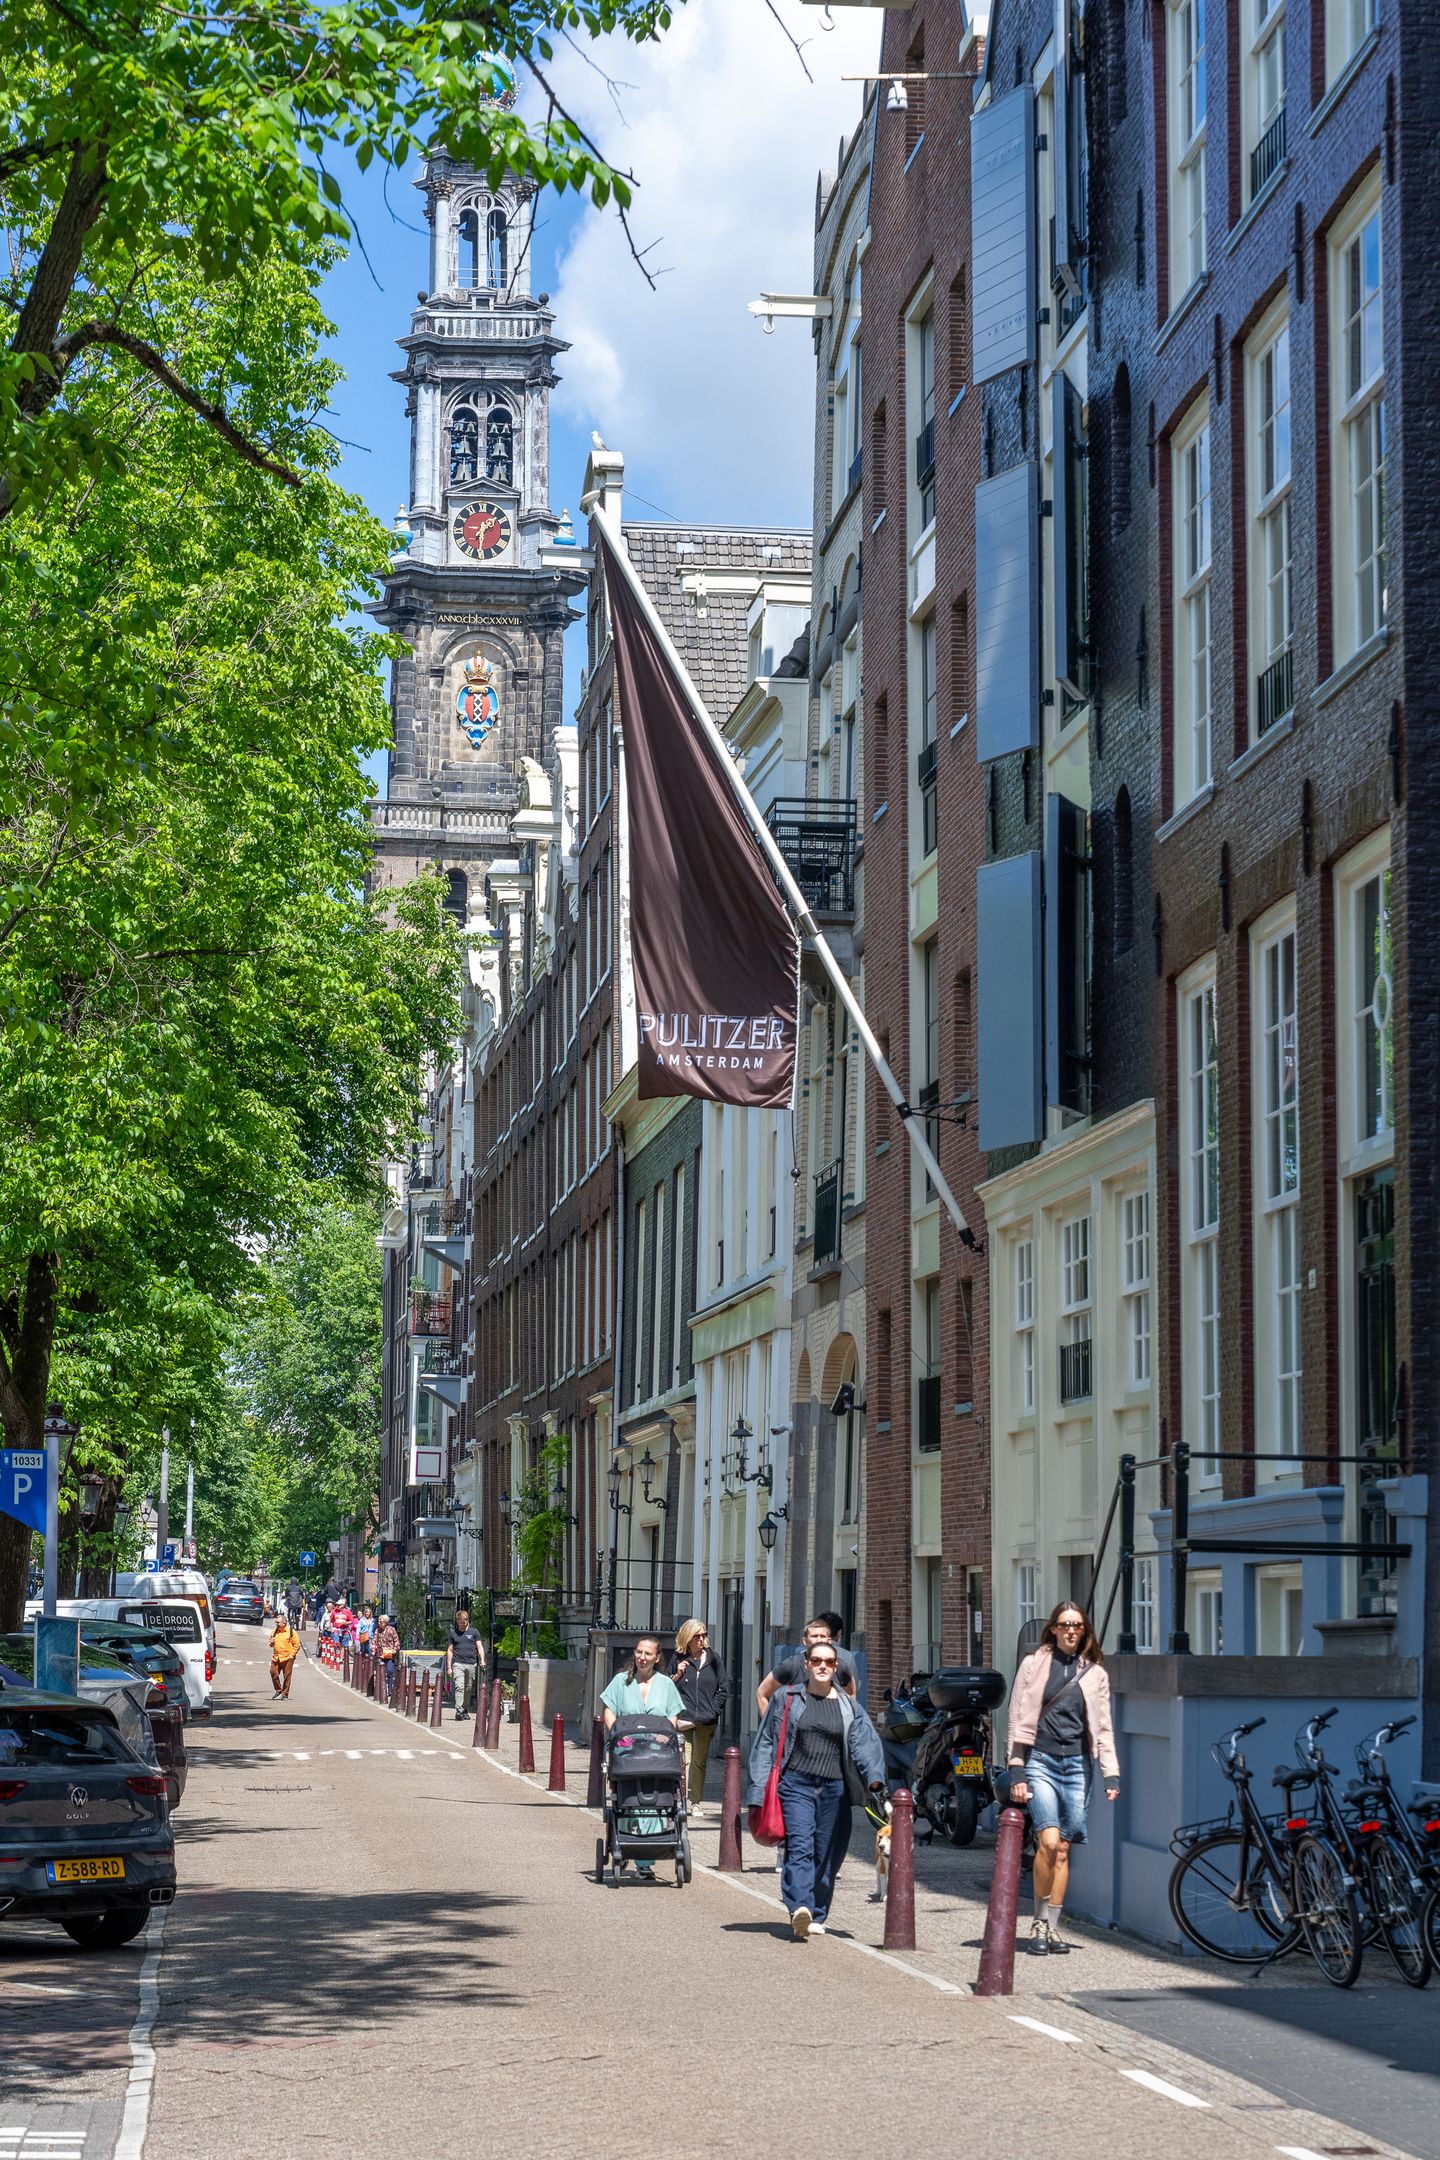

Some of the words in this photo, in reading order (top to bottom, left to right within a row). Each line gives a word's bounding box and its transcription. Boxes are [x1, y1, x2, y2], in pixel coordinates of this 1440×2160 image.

[639, 1012, 785, 1050] PULITZER
[656, 1053, 764, 1070] AMSTERDAM
[14, 1456, 41, 1466] 10331
[14, 1473, 32, 1505] P
[150, 1615, 162, 1625] DE
[164, 1615, 194, 1625] DROOG
[58, 1861, 119, 1878] Z-588-RD
